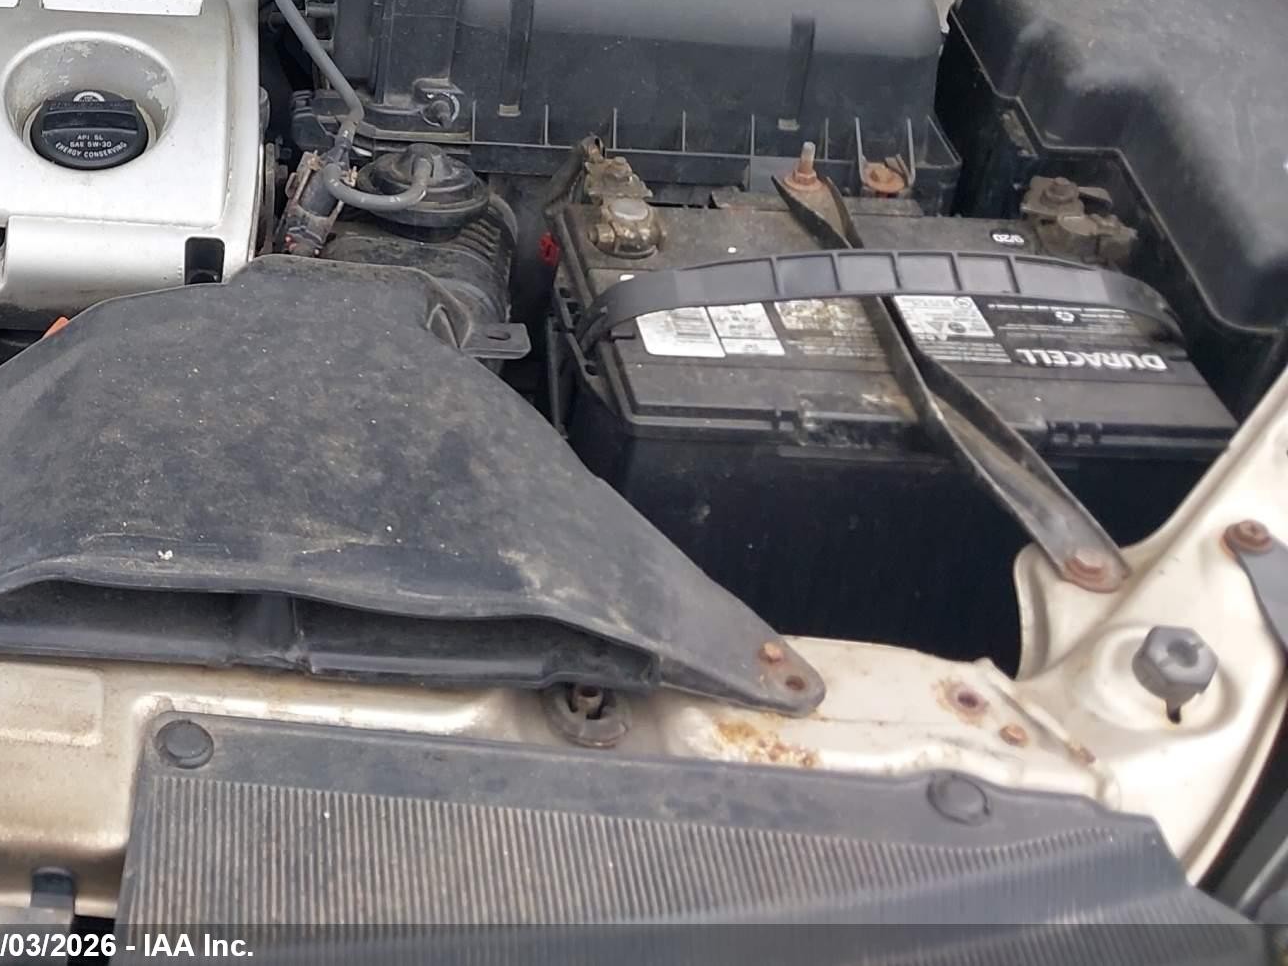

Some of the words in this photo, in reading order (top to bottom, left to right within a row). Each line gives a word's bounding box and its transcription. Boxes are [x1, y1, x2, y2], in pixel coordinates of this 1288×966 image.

[55, 141, 82, 158] ENERGY
[83, 141, 128, 159] CONSERVING
[69, 140, 84, 148] SAE
[1015, 348, 1168, 371] DURACELL
